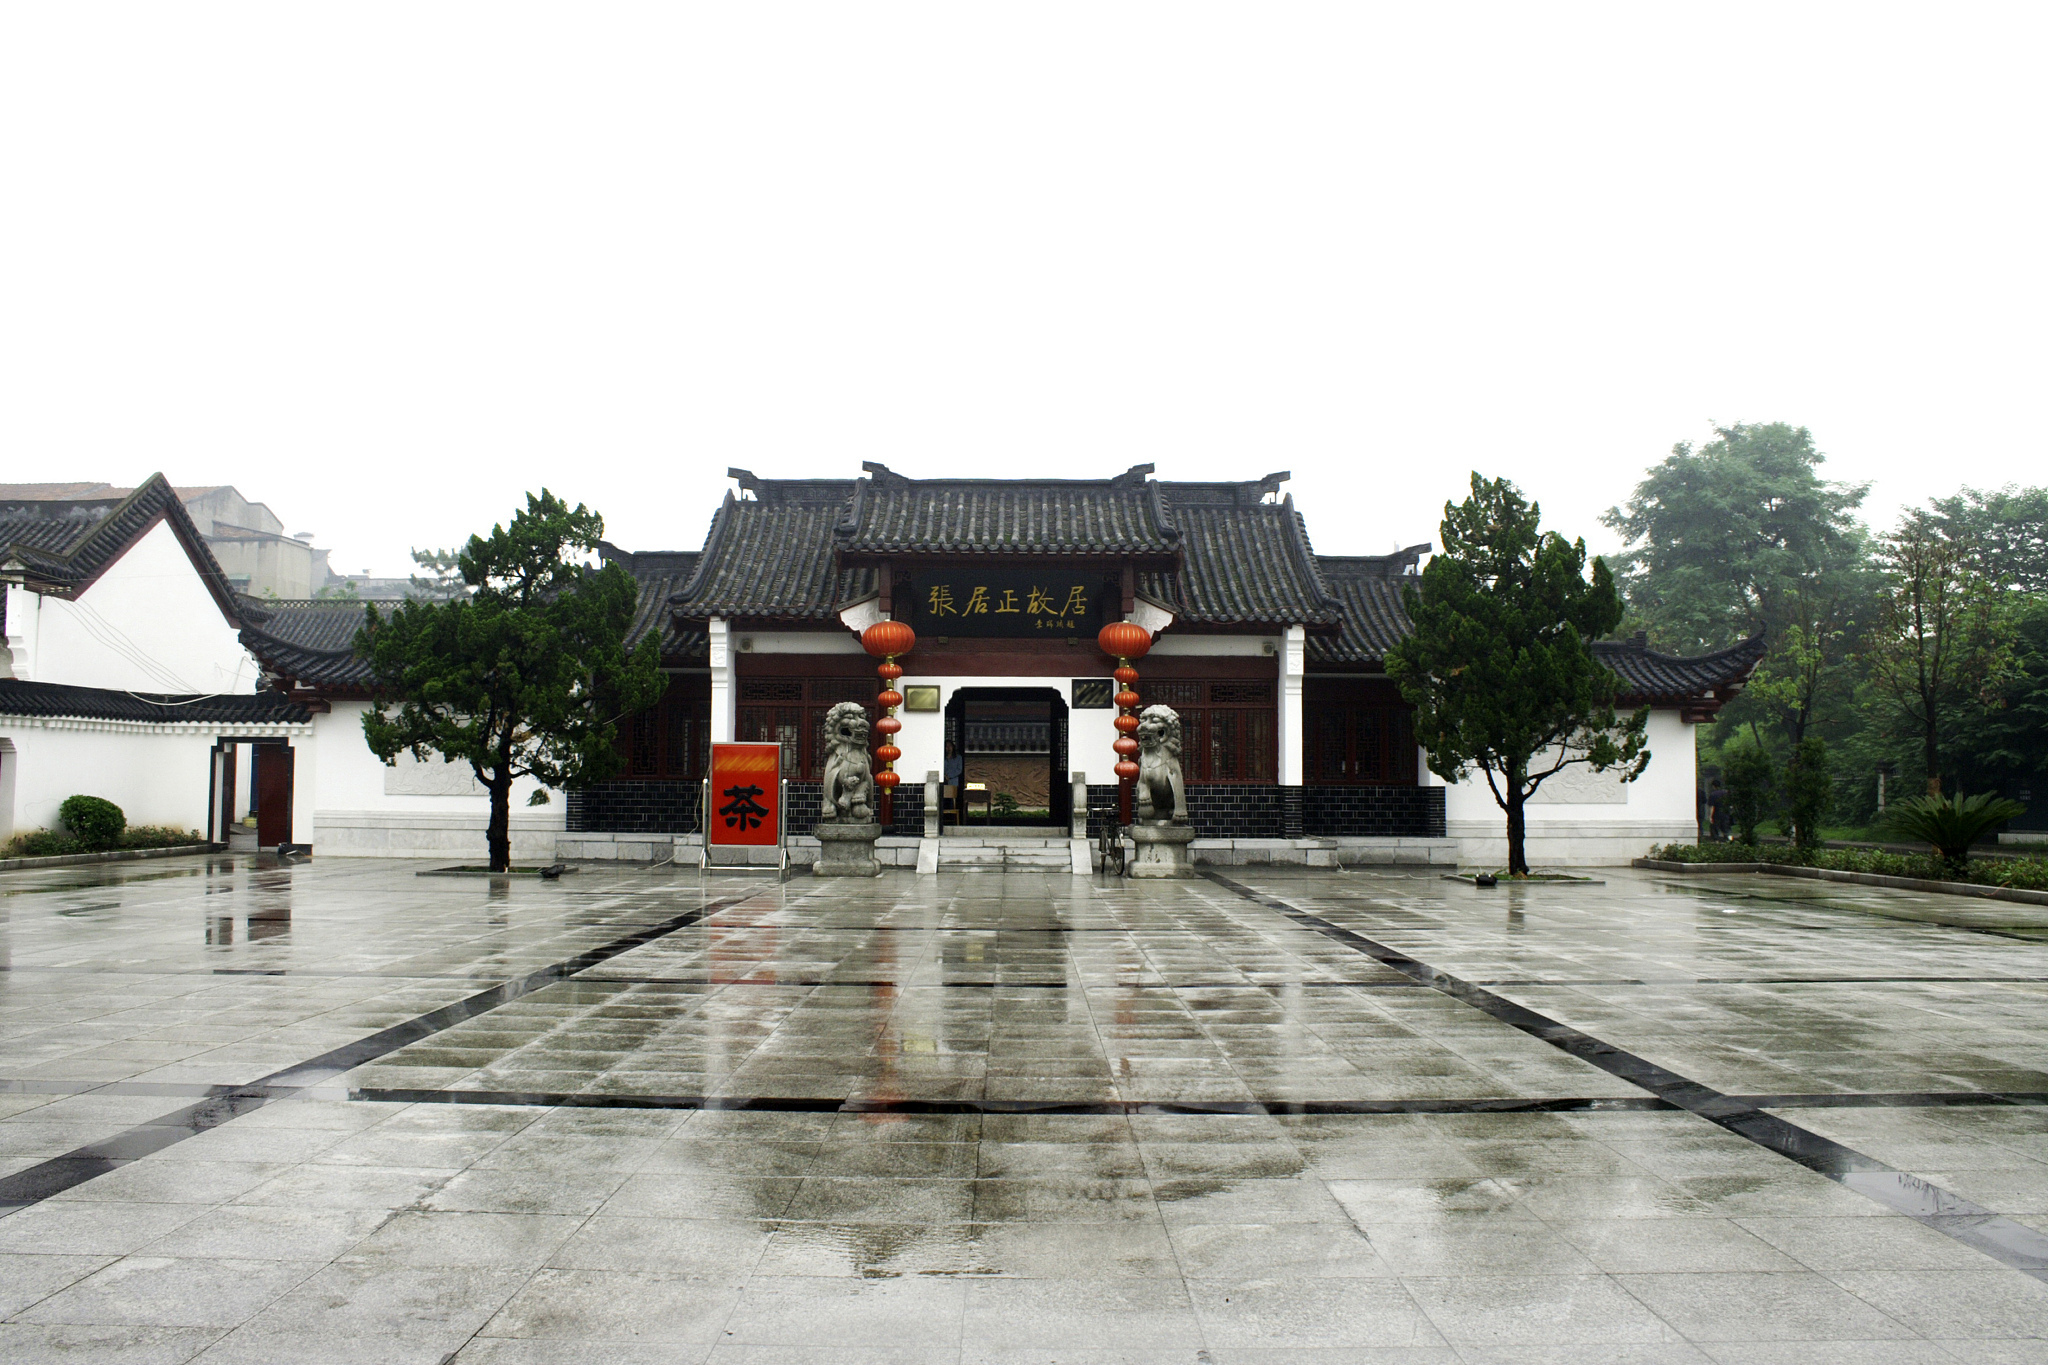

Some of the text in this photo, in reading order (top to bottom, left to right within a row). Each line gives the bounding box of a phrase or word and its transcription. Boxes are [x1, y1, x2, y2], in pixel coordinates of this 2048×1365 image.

[928, 585, 1088, 617] 張居正故居
[719, 784, 769, 832] 茶
